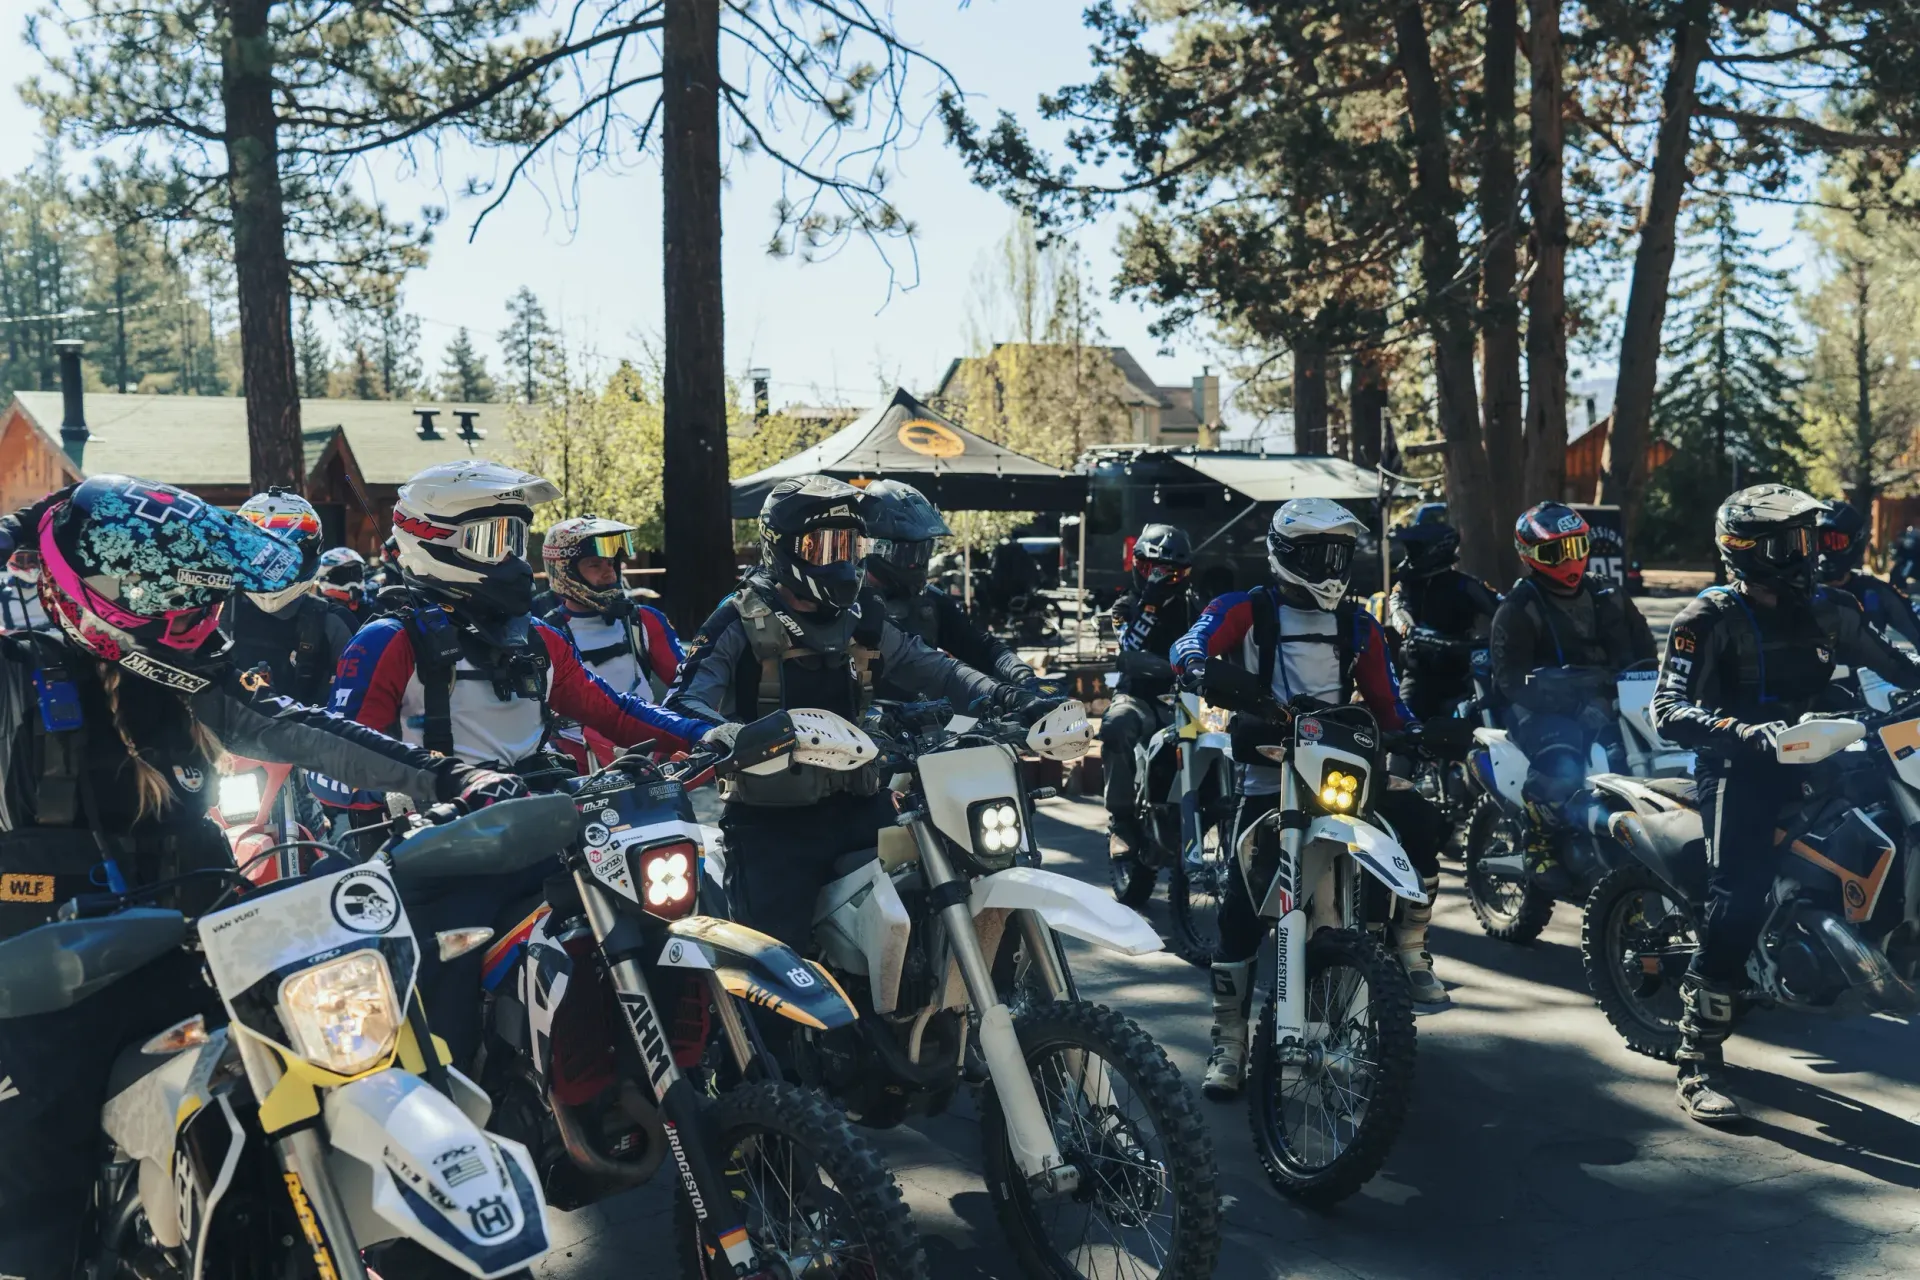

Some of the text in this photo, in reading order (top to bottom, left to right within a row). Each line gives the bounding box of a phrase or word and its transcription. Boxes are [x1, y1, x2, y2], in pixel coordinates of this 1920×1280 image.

[179, 572, 230, 588] Muc-Off
[1674, 636, 1696, 654] 05
[212, 920, 232, 933] VAN
[1277, 926, 1289, 1003] BRIDGESTONE
[617, 992, 671, 1088] AHM
[662, 1121, 708, 1222] BRIDGESTON
